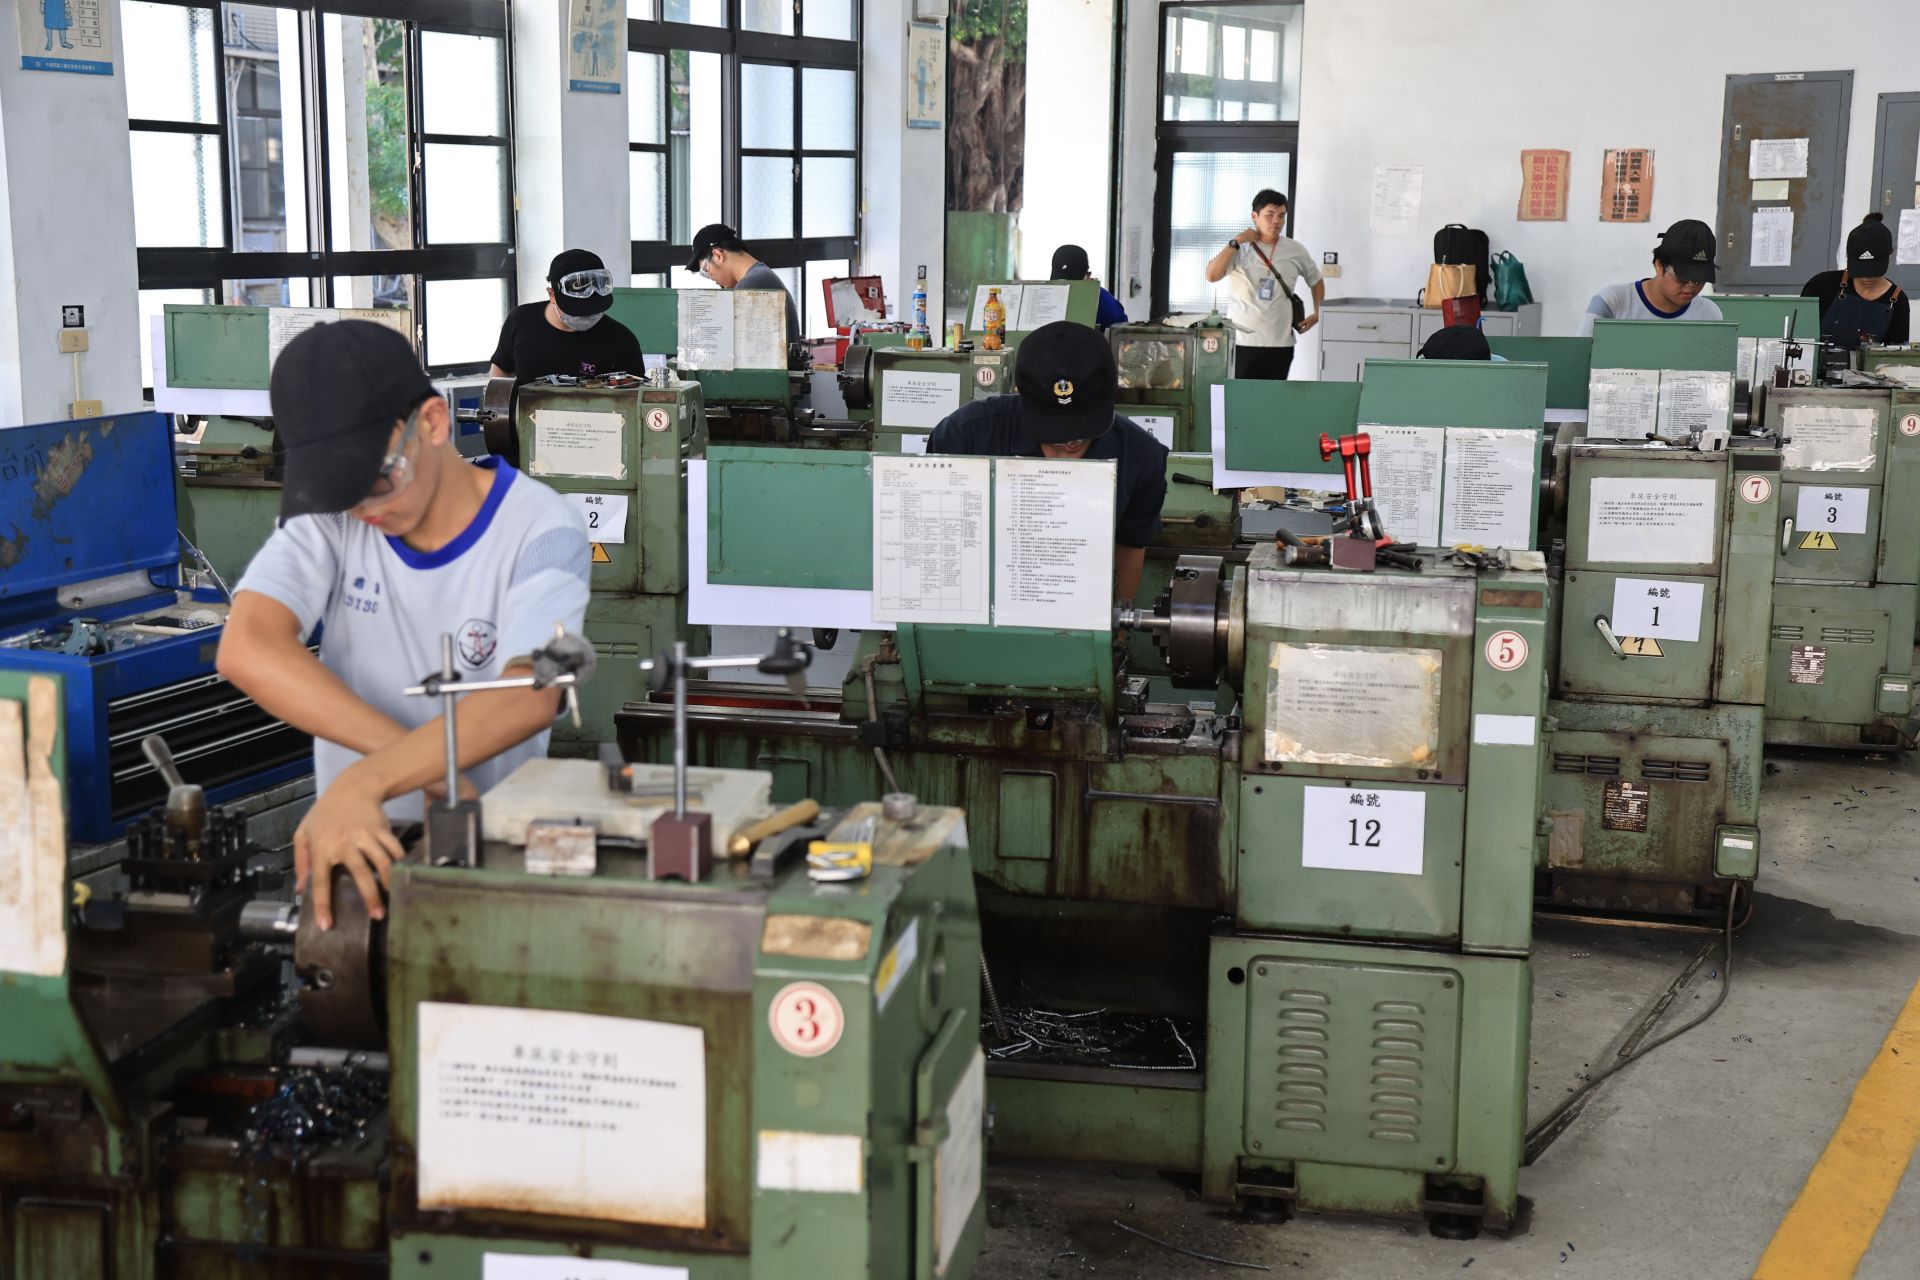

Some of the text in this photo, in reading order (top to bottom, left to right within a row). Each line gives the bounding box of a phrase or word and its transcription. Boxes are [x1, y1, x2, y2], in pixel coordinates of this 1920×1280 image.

[981, 369, 993, 383] 10
[653, 412, 663, 428] 8
[1907, 417, 1917, 432] 9
[1750, 480, 1762, 499] 7
[1824, 492, 1843, 501] 編號
[585, 496, 604, 505] 編號
[589, 511, 599, 529] 2
[1827, 507, 1837, 523] 3
[1647, 587, 1671, 599] 編號
[1651, 606, 1660, 627] 1
[1499, 638, 1515, 663] 5
[1349, 793, 1381, 808] 編號
[1348, 818, 1381, 848] 12
[795, 1000, 820, 1041] 3
